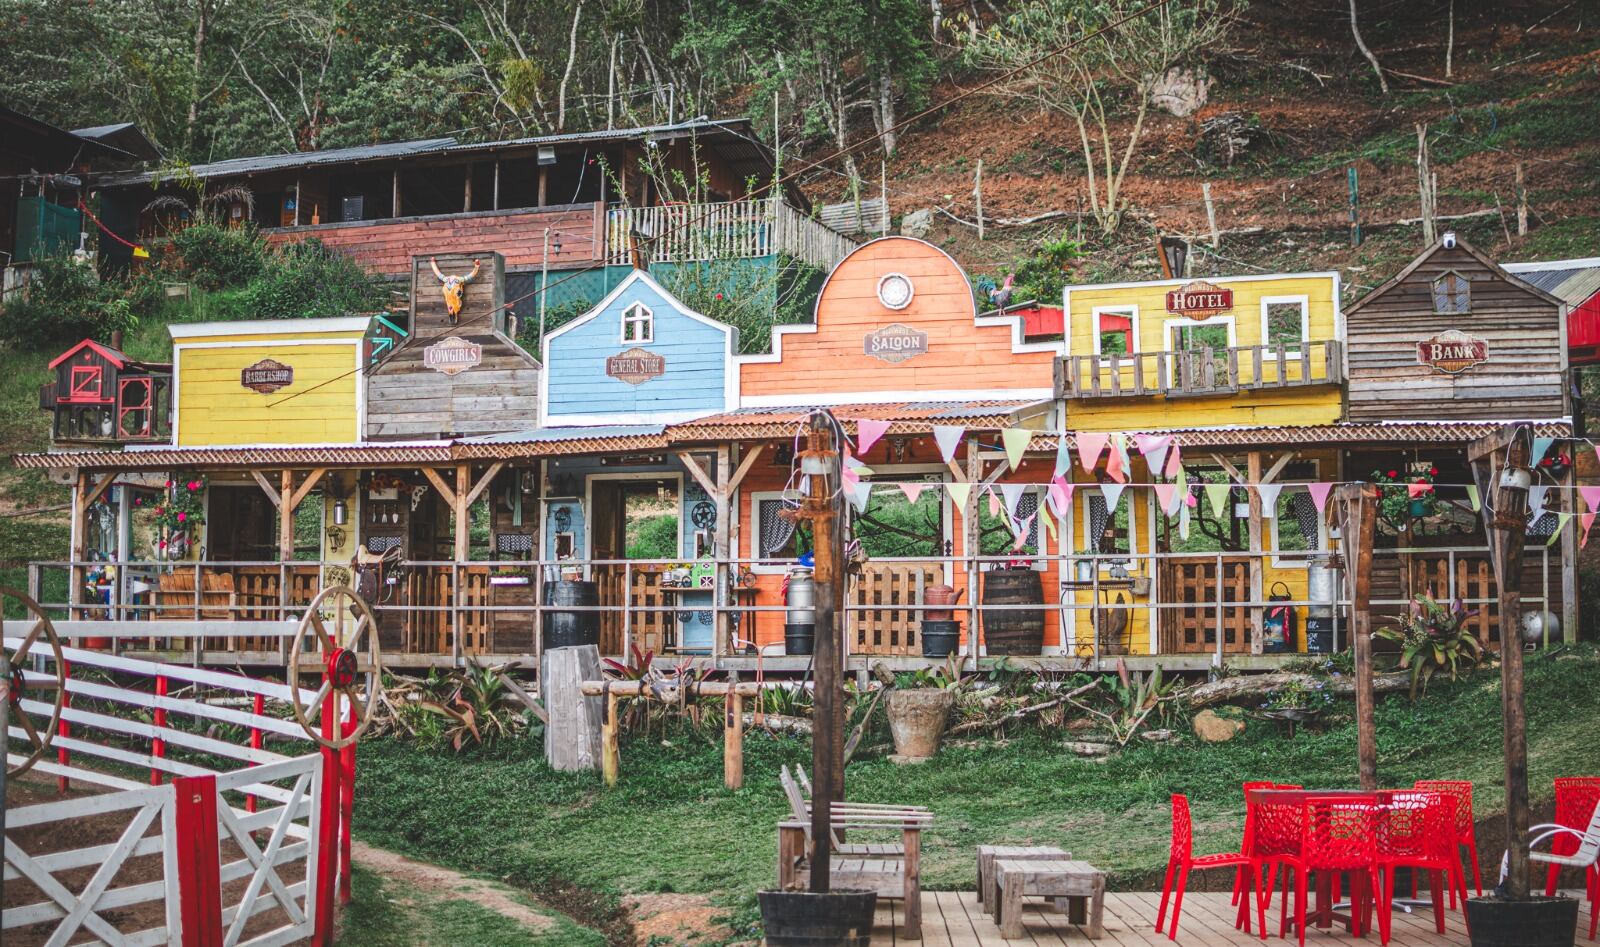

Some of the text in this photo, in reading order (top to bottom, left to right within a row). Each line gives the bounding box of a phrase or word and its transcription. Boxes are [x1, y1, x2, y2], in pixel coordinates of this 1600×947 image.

[1172, 292, 1226, 310] HOTEL
[871, 335, 920, 352] SALOON
[1430, 343, 1475, 361] BANK
[429, 347, 477, 364] COWGIRLS
[610, 357, 661, 375] GENERAL STORE
[245, 369, 289, 384] BARBERSHOP
